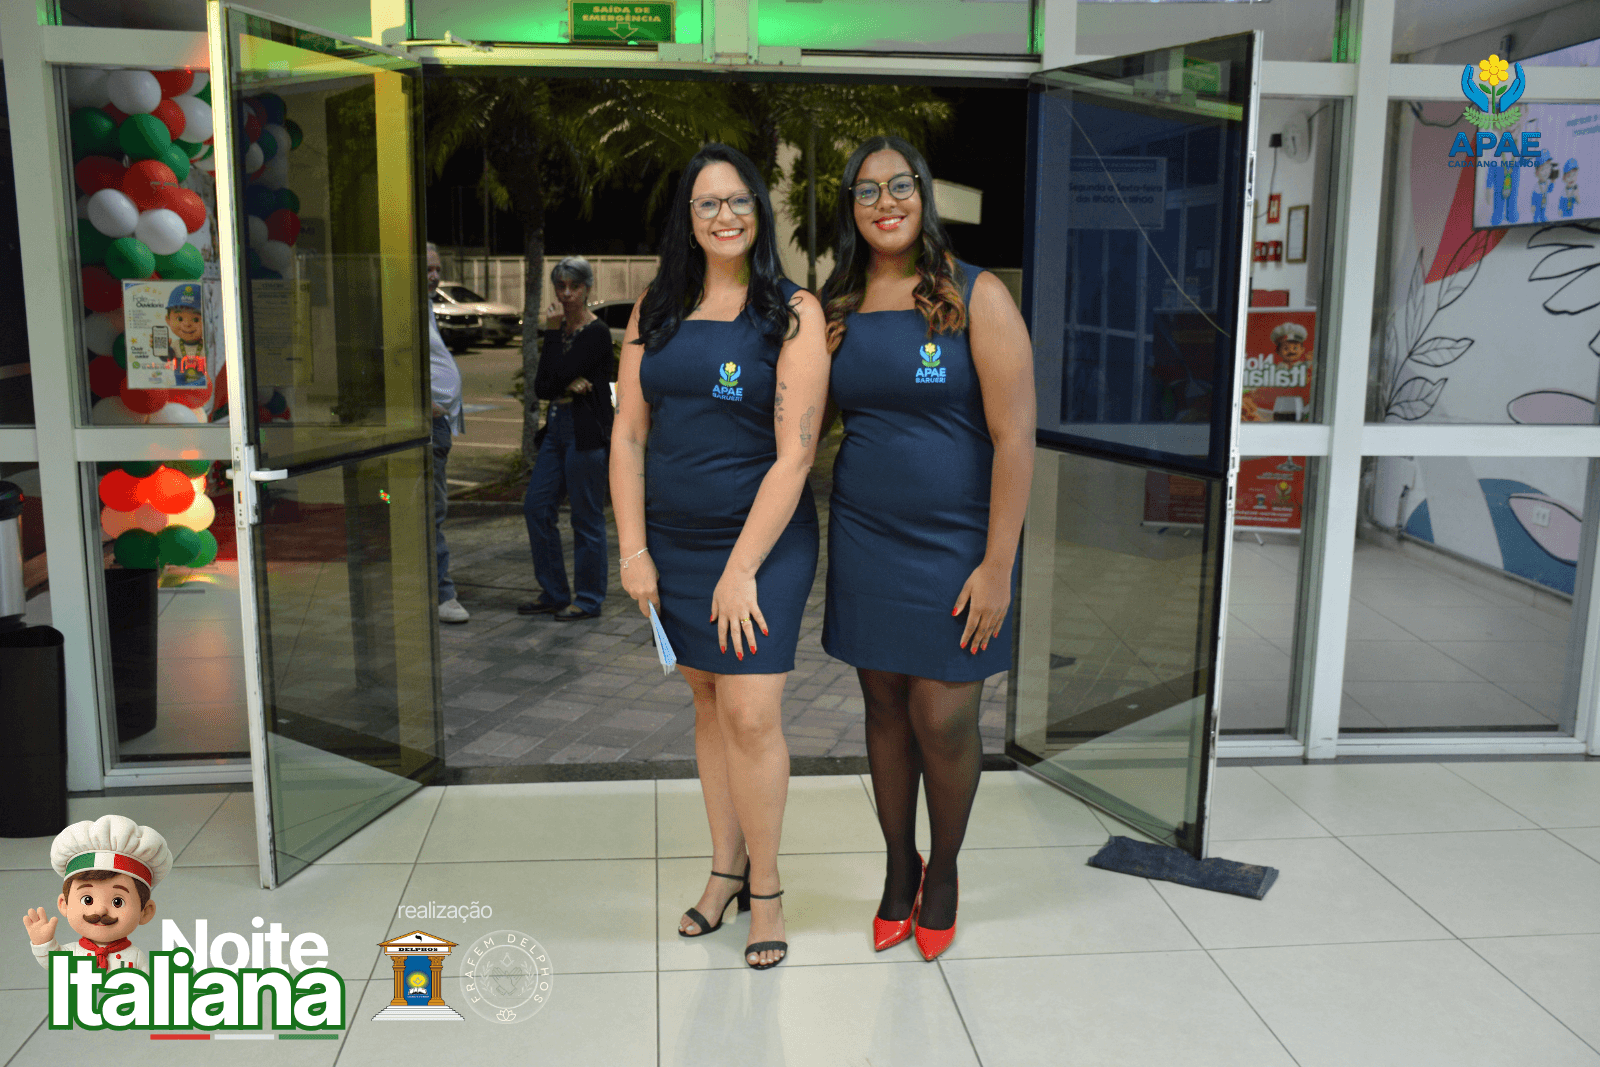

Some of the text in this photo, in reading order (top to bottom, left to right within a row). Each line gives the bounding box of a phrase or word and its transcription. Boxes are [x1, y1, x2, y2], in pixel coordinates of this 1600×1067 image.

[593, 5, 631, 13] SAÍDA
[582, 14, 661, 22] EMERGÊNCIA
[915, 367, 947, 377] APAE
[712, 384, 743, 397] APAE
